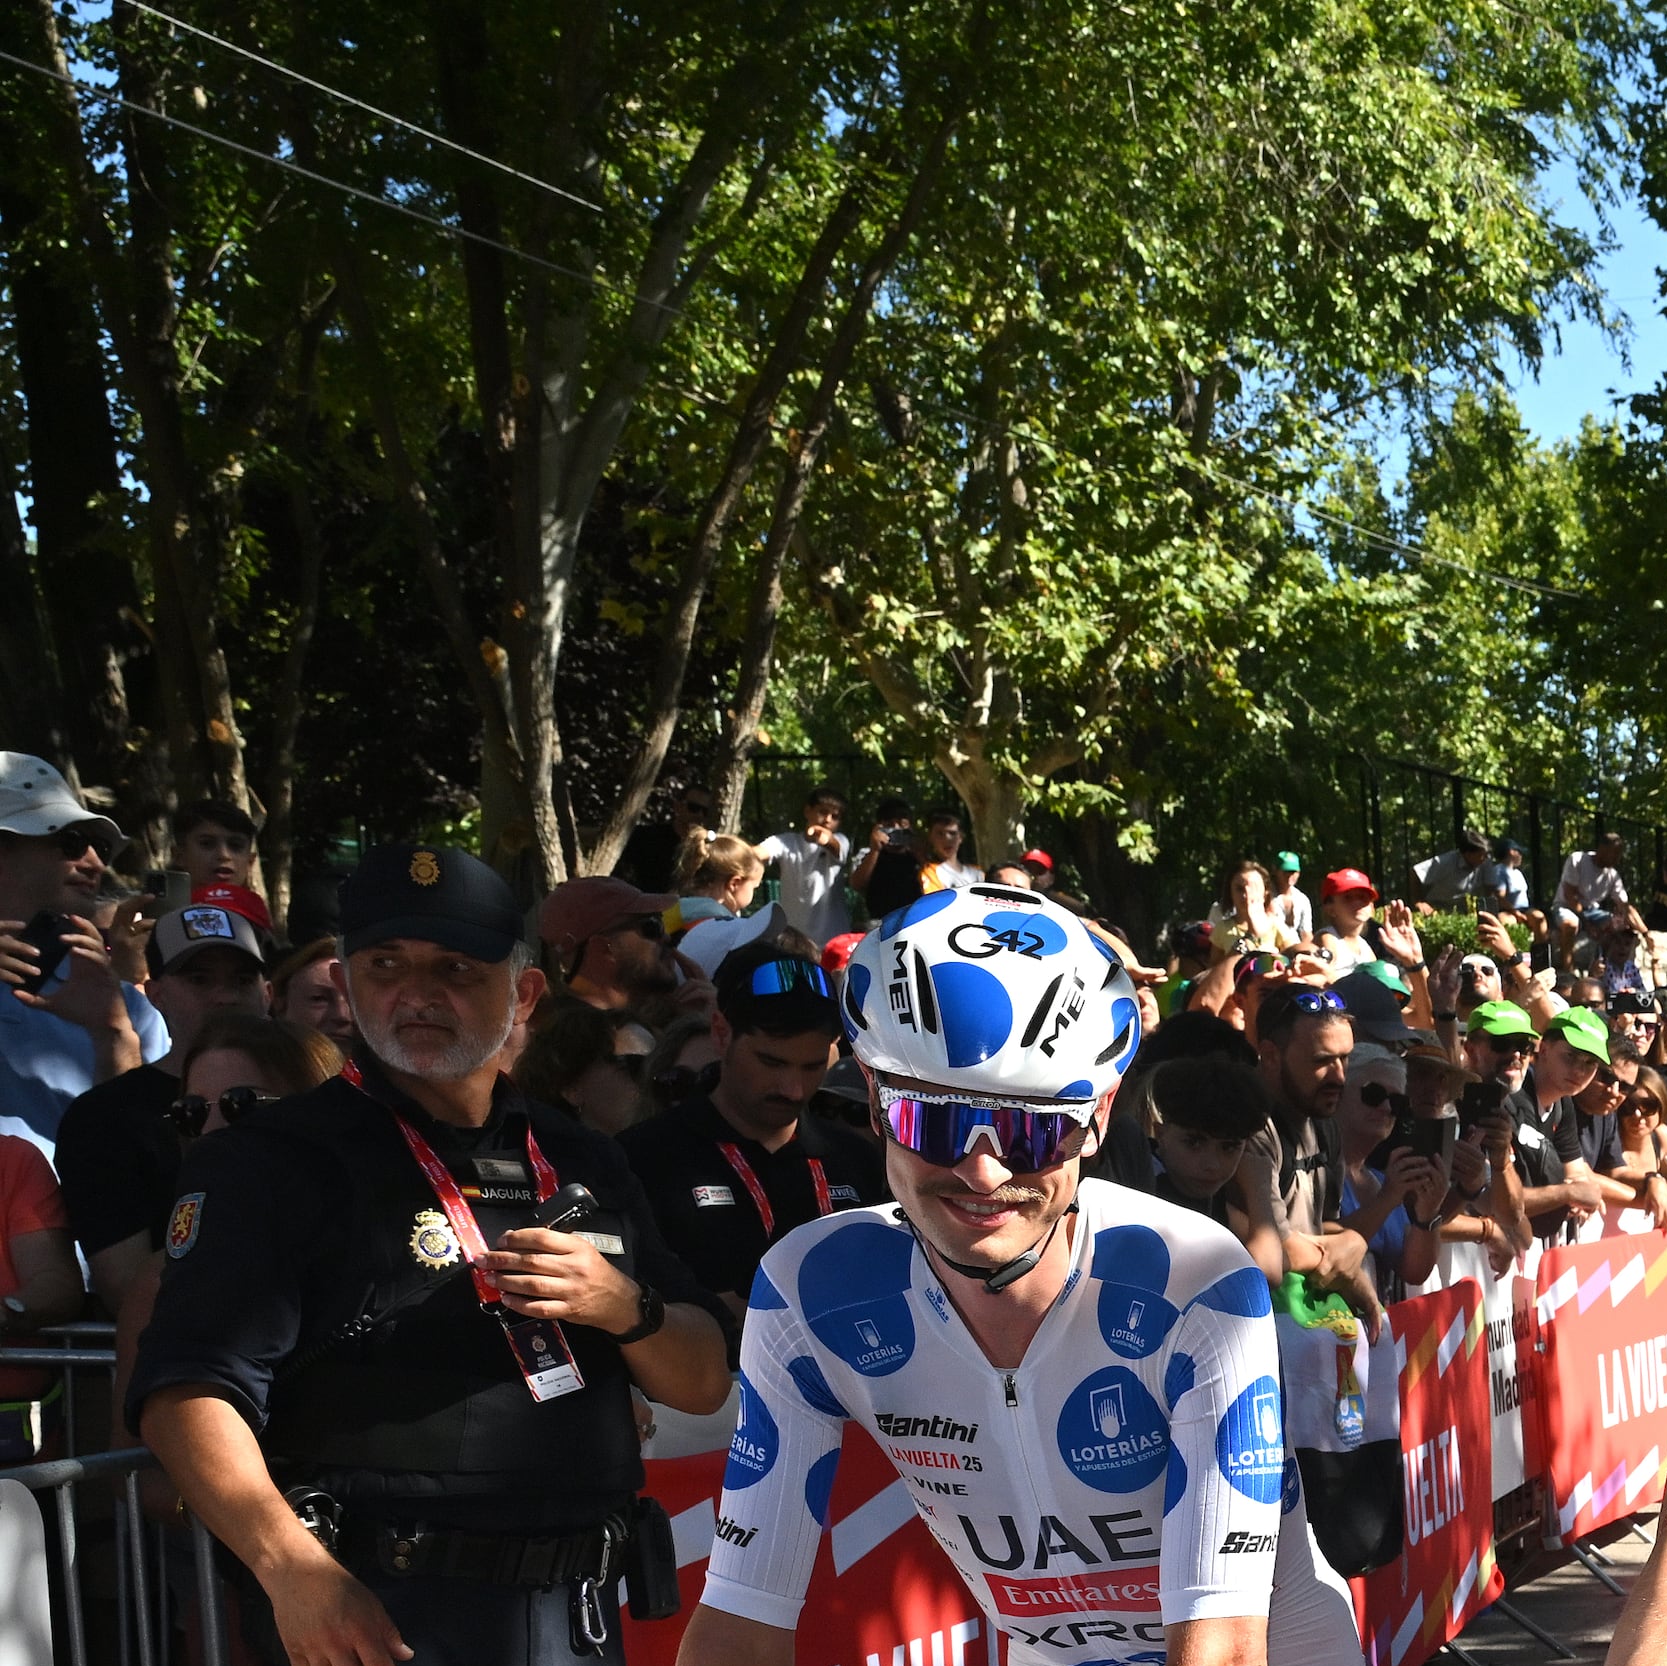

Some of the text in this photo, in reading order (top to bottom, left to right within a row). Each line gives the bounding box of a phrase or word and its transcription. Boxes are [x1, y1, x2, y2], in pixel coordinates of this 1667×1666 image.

[948, 923, 1045, 961] G42
[889, 941, 917, 1033] MET
[1040, 967, 1085, 1058] MET
[481, 1188, 532, 1200] JAGUAR
[874, 1412, 979, 1444] Santini
[903, 1449, 983, 1474] VUELTA 25
[1070, 1430, 1164, 1464] LOTERÍAS
[915, 1476, 969, 1498] VINE
[1403, 1424, 1465, 1547] UELTA
[957, 1510, 1162, 1573] UAE
[1003, 1581, 1161, 1607] Emirates
